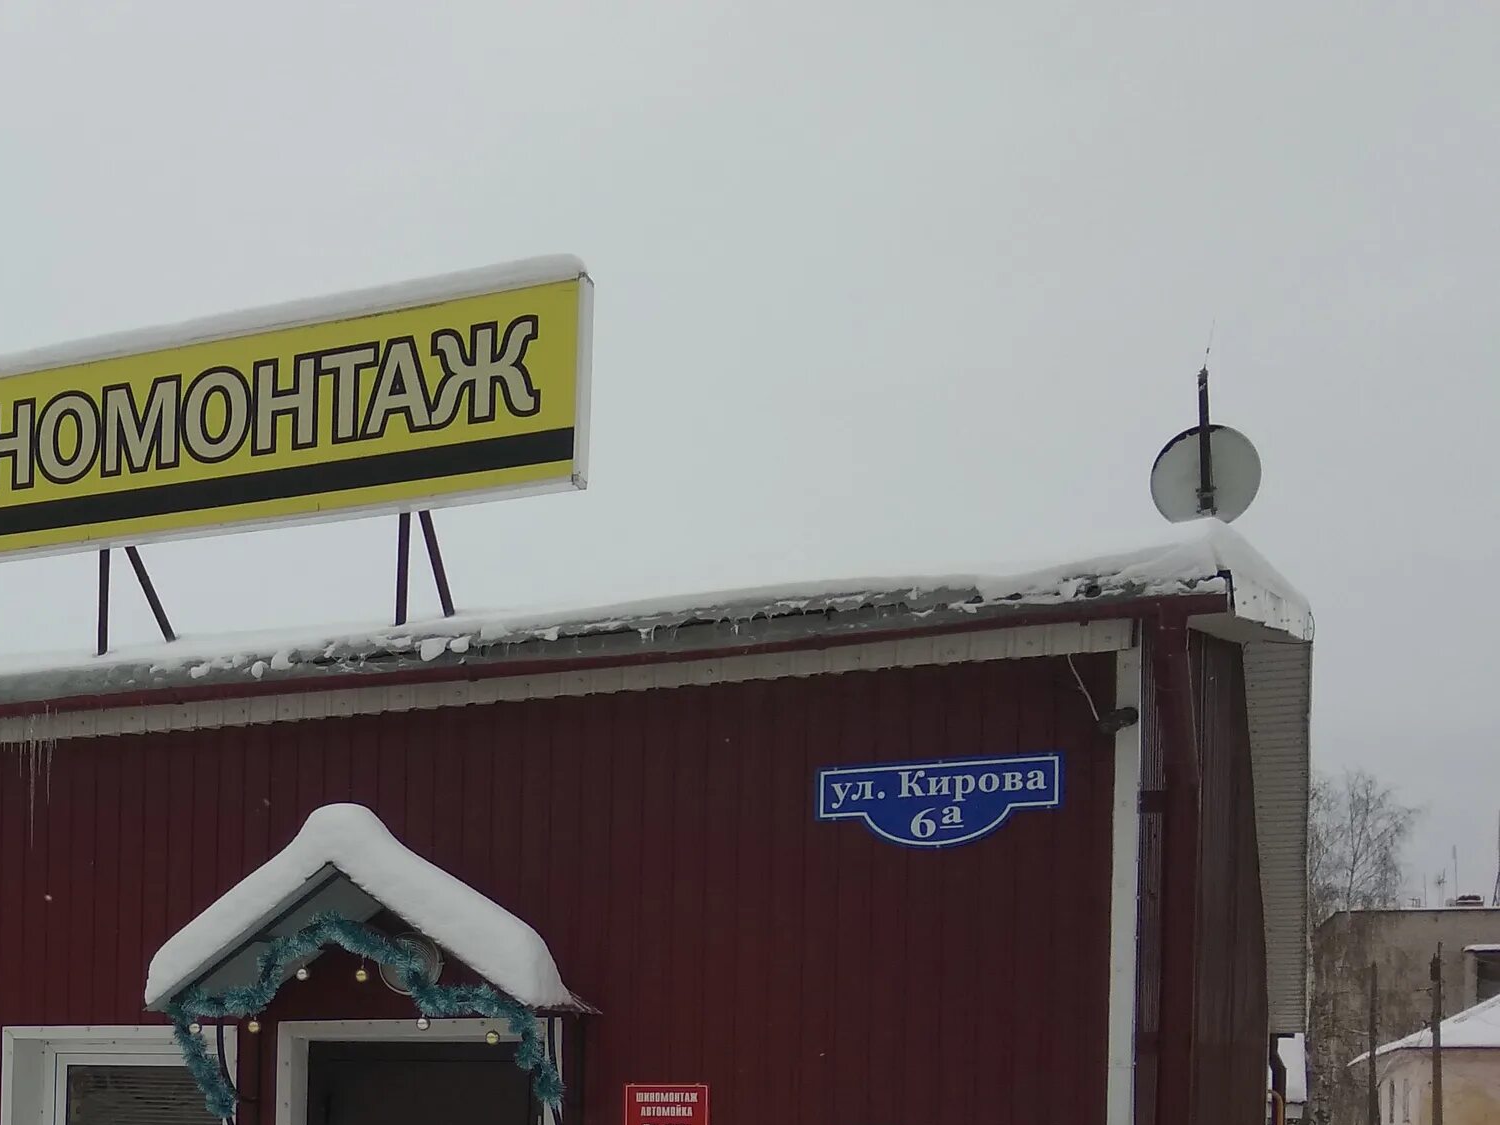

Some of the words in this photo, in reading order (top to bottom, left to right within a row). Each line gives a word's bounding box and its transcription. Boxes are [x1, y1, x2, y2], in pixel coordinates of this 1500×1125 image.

[831, 780, 886, 809] ул.
[897, 769, 1048, 802] Кирова
[636, 1092, 698, 1102] ШИНОМОНТАЖ
[640, 1104, 693, 1116] АВТОМОЙКА
